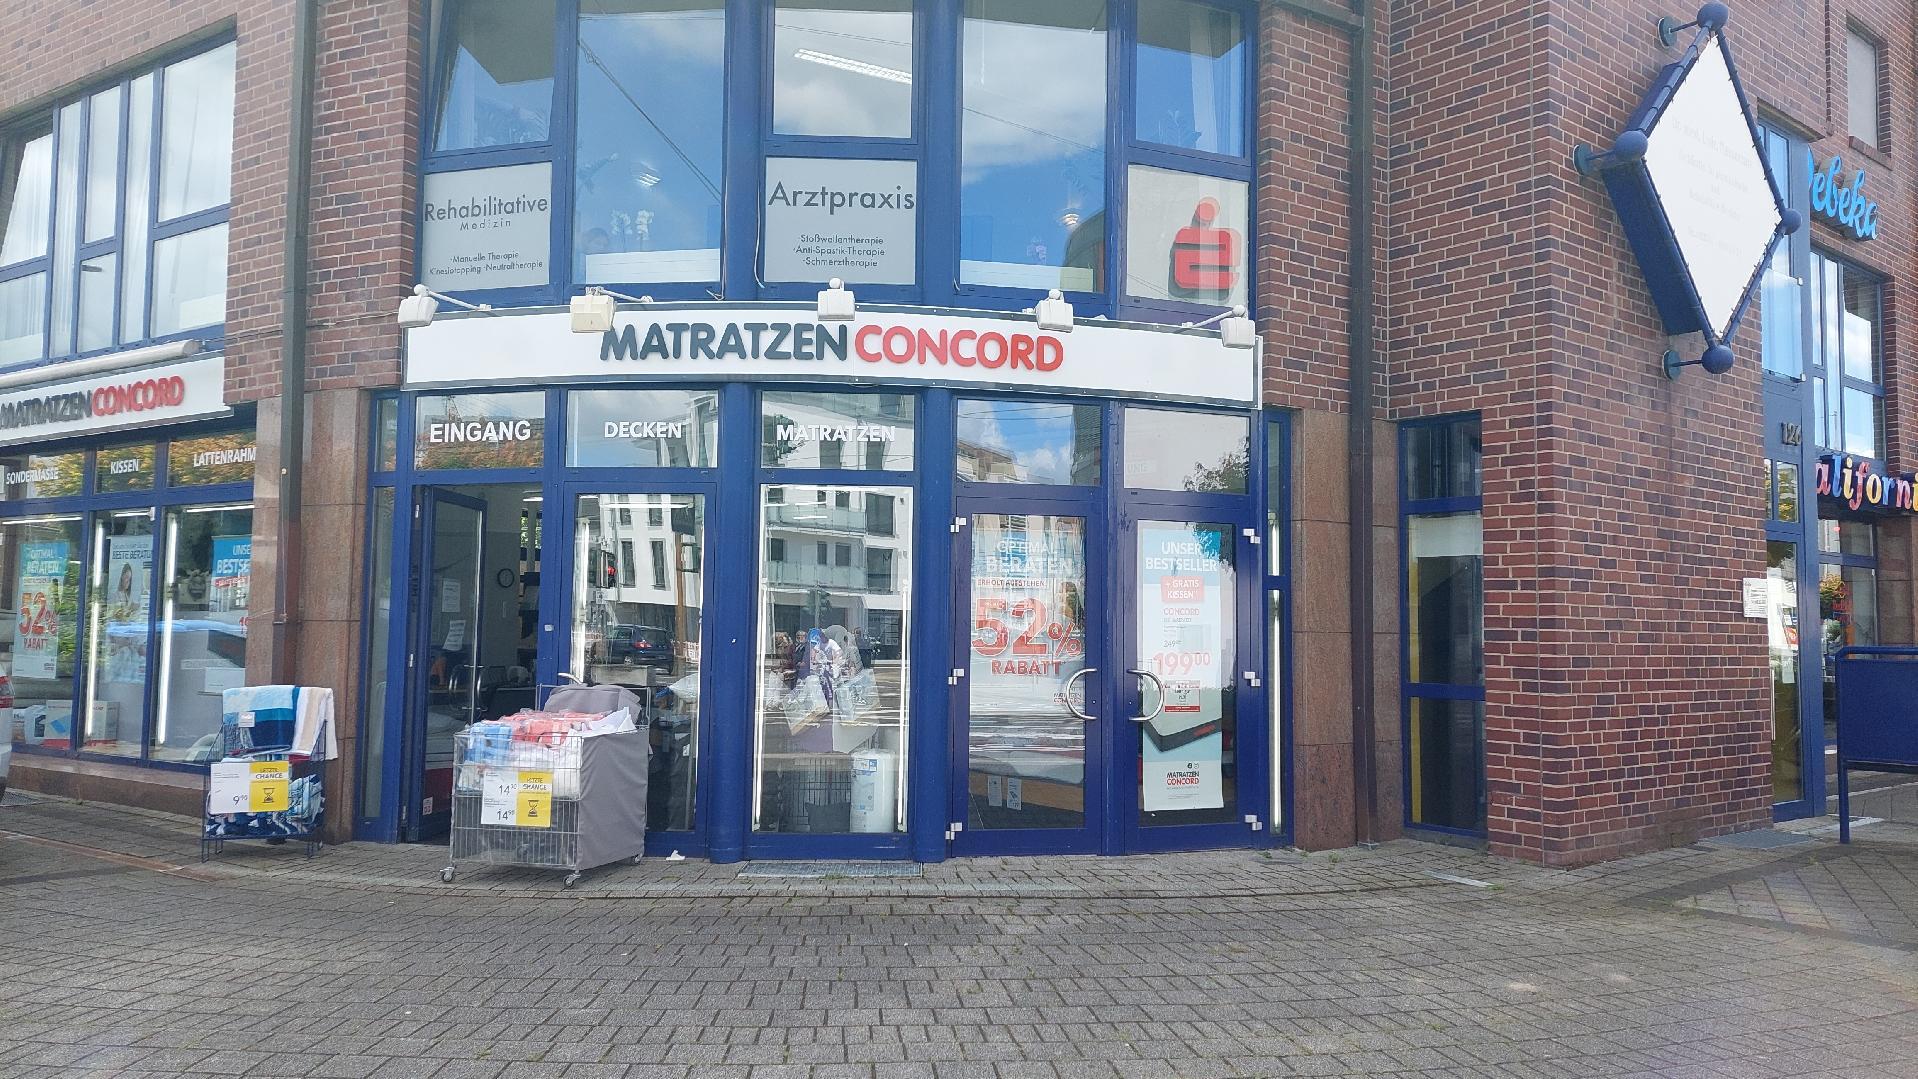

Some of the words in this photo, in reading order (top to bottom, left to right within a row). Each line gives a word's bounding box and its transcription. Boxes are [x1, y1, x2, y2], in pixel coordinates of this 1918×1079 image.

[768, 181, 915, 215] Arztpraxis
[1808, 144, 1878, 240] ebeka
[424, 194, 548, 221] Rehabilitative
[460, 218, 511, 231] Medizin
[599, 322, 848, 362] MATRATZEN
[854, 323, 1064, 372] CONCORD
[0, 389, 93, 431] MATRATZEN
[91, 375, 185, 418] CONCORD
[429, 419, 532, 443] EINGANG
[604, 421, 682, 438] DECKEN
[776, 423, 895, 442] MATRATZEN
[110, 458, 139, 475] KISSEN
[1161, 541, 1203, 556] UNSER
[985, 556, 1073, 574] BERATEN
[1145, 557, 1217, 572] BESTSELLER
[1173, 579, 1199, 588] GRATIS
[19, 591, 58, 635] 52%
[972, 597, 1082, 657] 52%
[1166, 778, 1200, 786] CONCORD
